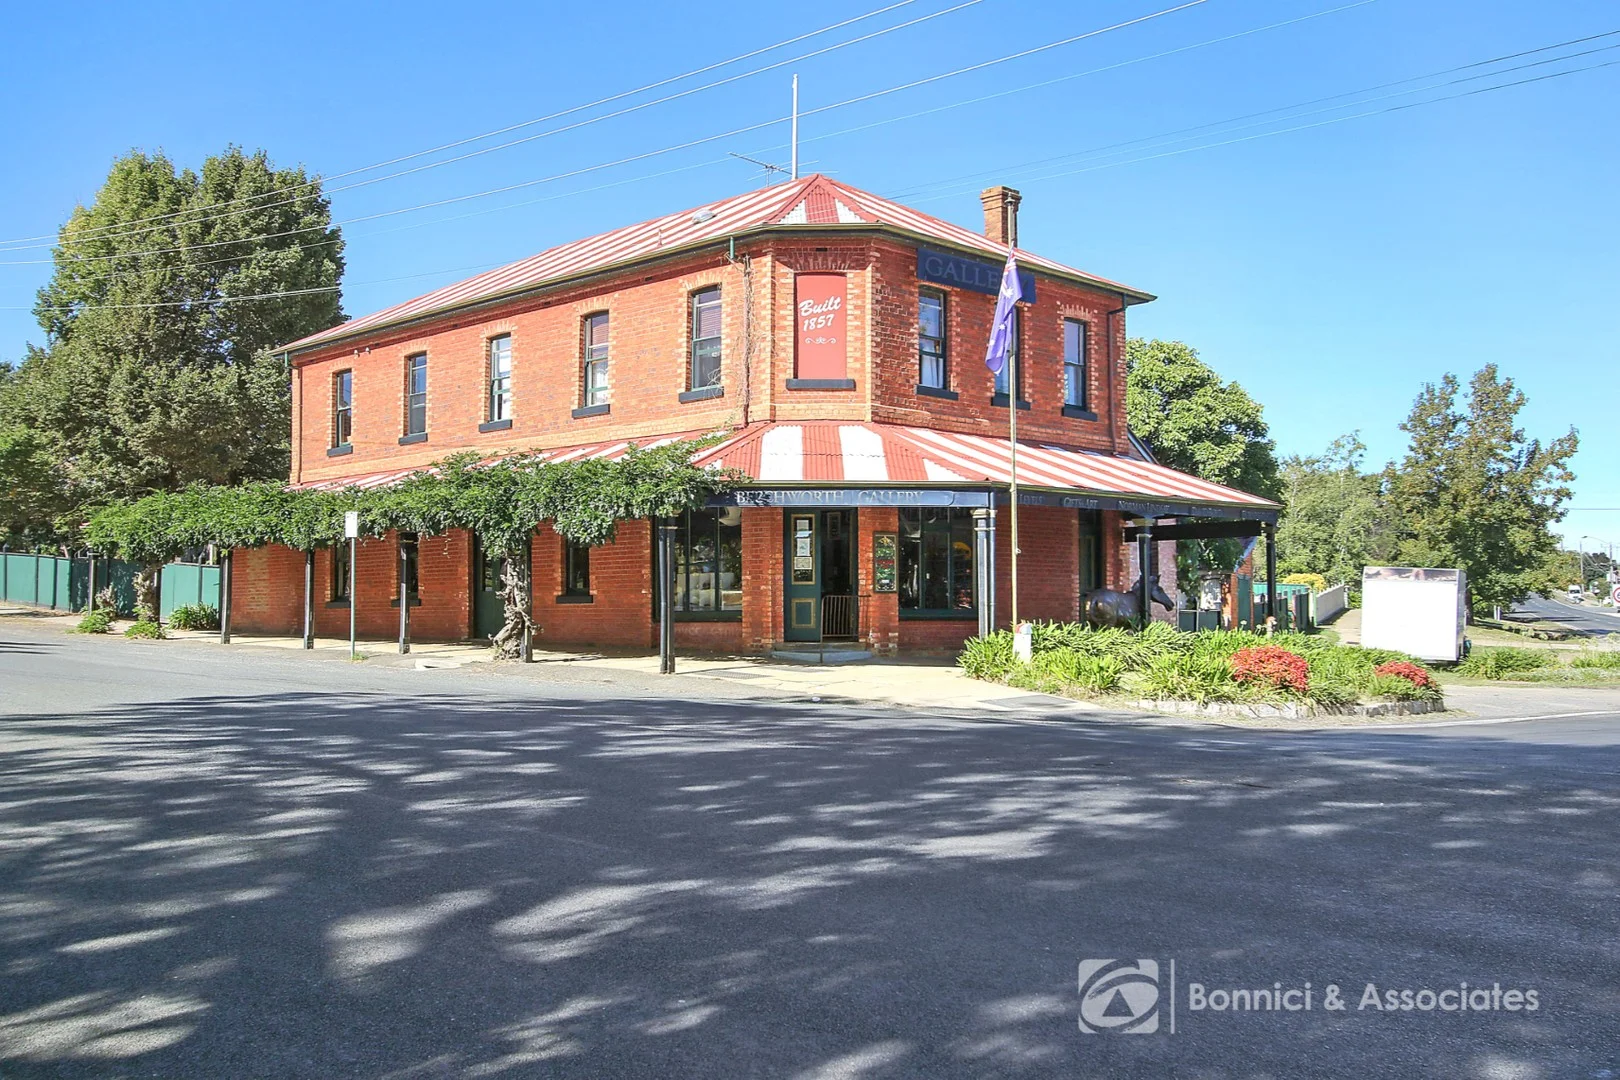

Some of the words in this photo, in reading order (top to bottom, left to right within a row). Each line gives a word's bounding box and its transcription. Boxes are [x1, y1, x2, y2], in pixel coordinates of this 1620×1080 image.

[925, 256, 1028, 295] GALLE
[798, 296, 841, 317] Built
[803, 313, 834, 332] 1857
